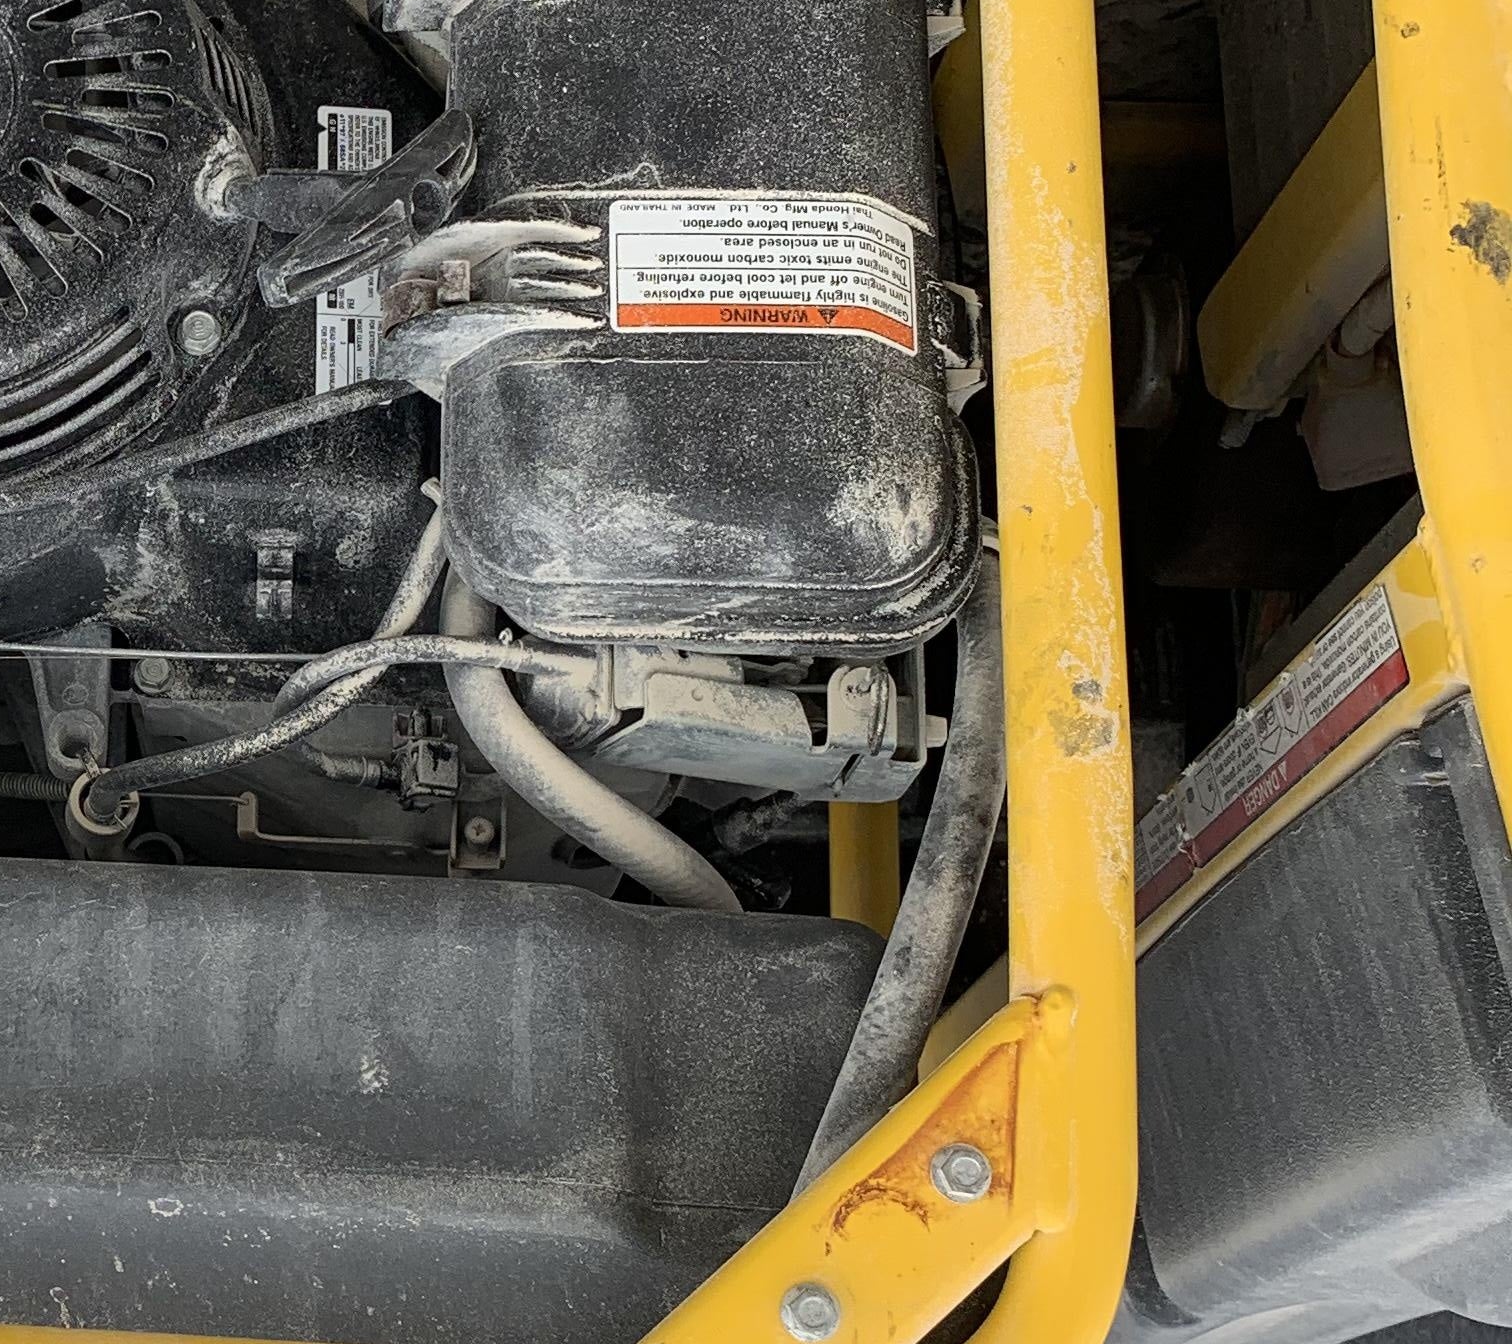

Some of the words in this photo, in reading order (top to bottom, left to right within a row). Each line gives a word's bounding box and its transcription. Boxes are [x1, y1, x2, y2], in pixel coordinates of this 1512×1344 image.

[812, 205, 849, 214] Honda
[852, 206, 873, 219] Thai
[680, 218, 742, 231] operation.
[748, 220, 788, 231] before
[792, 220, 838, 231] Manual
[842, 221, 883, 239] Owner's
[721, 238, 754, 248] area.
[759, 238, 818, 249] enclosed
[823, 239, 838, 249] an
[843, 239, 854, 249] in
[859, 242, 876, 254] run
[885, 233, 906, 251] Read
[655, 254, 722, 265] monoxide.
[728, 254, 774, 265] carbon
[779, 255, 811, 266] toxic
[816, 255, 852, 266] emits
[879, 248, 892, 261] not
[856, 257, 889, 276] engine
[895, 256, 907, 270] Do
[633, 271, 694, 284] refueling.
[699, 274, 742, 285] before
[747, 274, 775, 285] cool
[780, 275, 796, 285] let
[801, 275, 825, 284] and
[830, 275, 848, 286] off
[853, 275, 887, 291] engine
[892, 271, 907, 286] The
[640, 288, 705, 301] explosive.
[710, 290, 734, 301] and
[739, 289, 811, 302] flammable
[816, 288, 855, 303] highly
[859, 293, 868, 305] is
[890, 289, 909, 306] Turn
[720, 308, 808, 323] WARNING
[871, 297, 909, 322] Gasoline
[1240, 767, 1280, 816] DANGER
